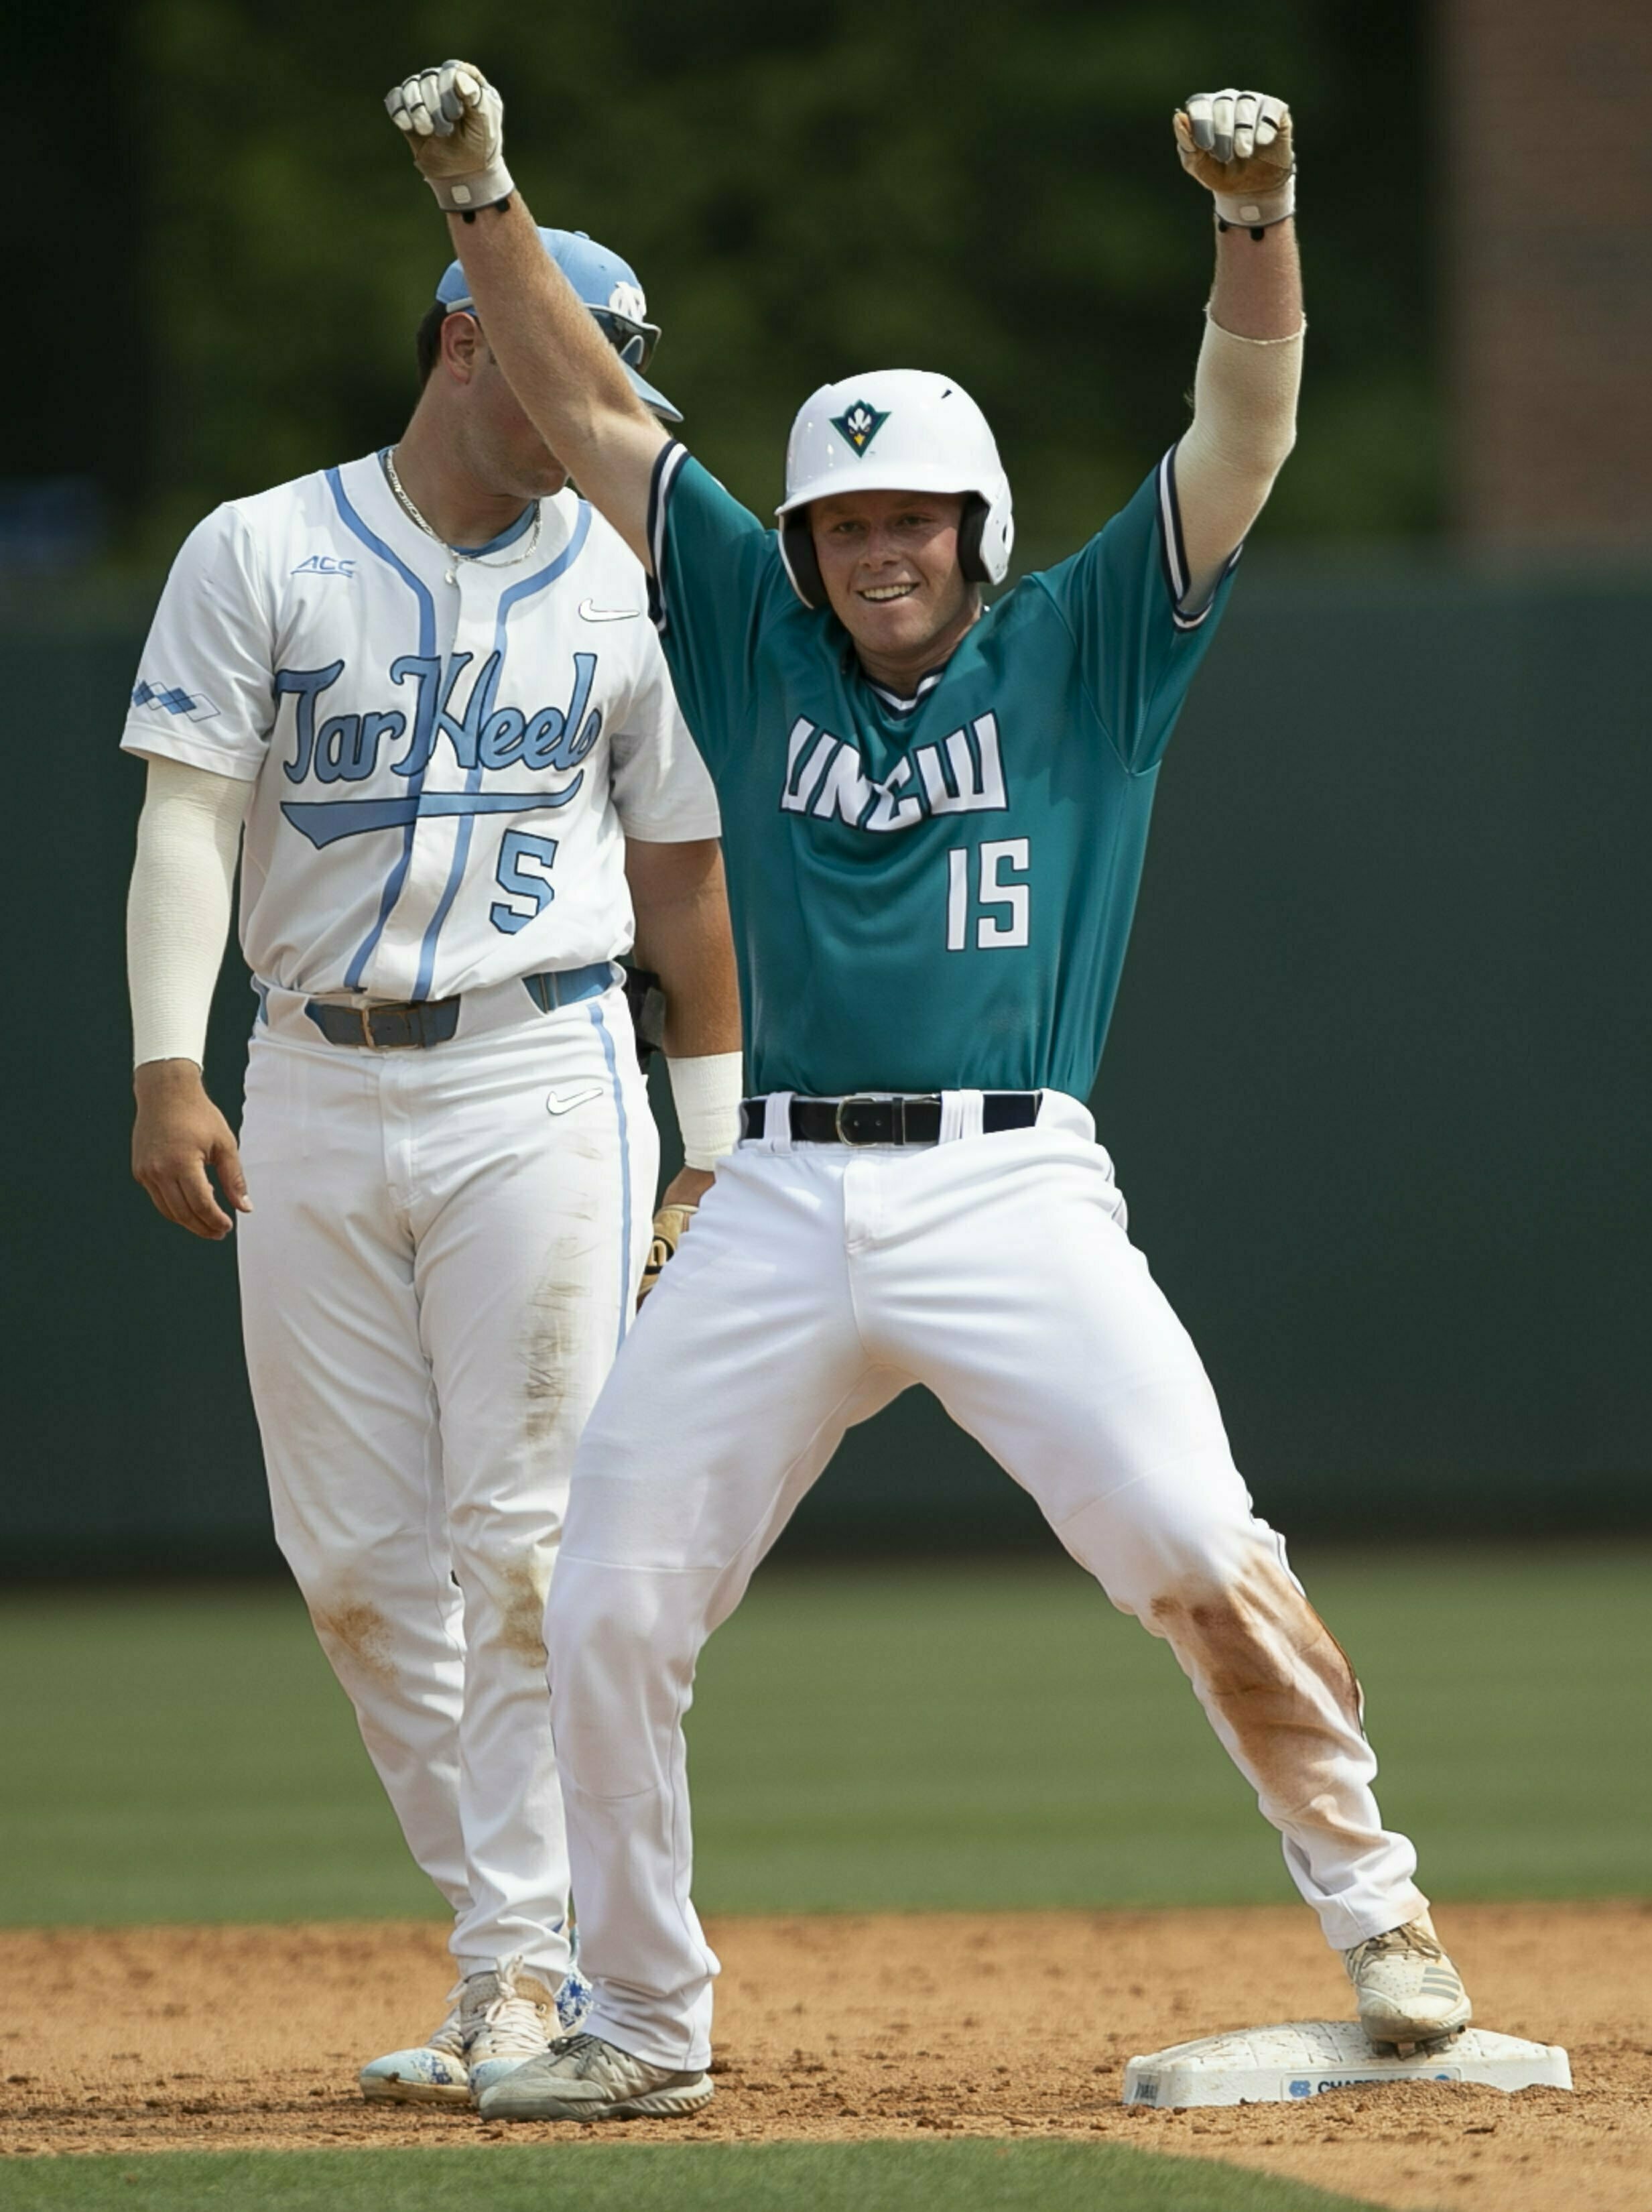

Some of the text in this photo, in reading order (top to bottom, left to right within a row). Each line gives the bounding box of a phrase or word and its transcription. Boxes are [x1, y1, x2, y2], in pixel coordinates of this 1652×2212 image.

[297, 555, 356, 575] ACC
[275, 651, 602, 784] Tar Heels
[779, 709, 1009, 833] UNCW
[489, 828, 559, 934] 5
[946, 837, 1030, 952] 15
